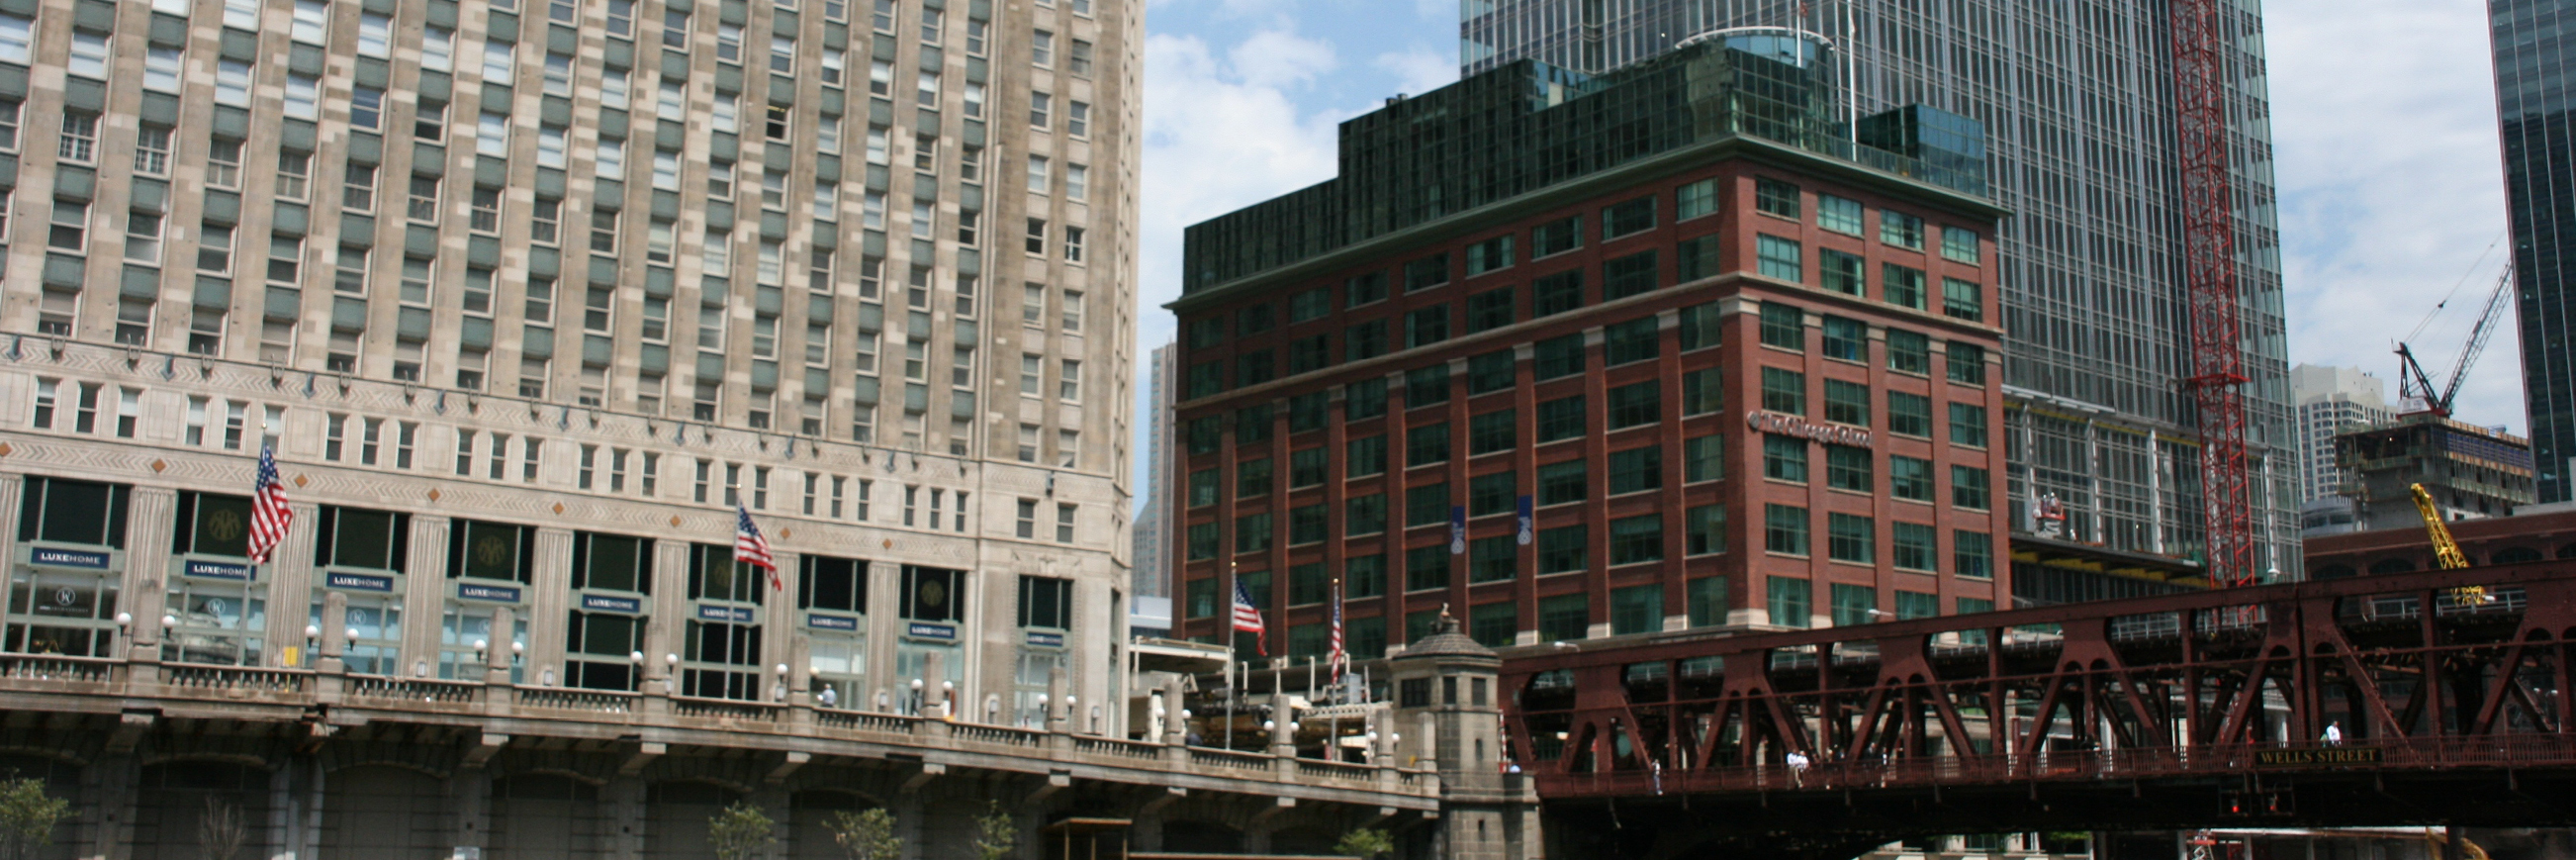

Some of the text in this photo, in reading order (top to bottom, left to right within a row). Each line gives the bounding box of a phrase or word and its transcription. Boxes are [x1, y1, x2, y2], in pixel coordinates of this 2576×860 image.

[41, 552, 101, 565] LUXEHOME
[333, 576, 386, 588] LUXEHOME
[464, 588, 513, 599] LUXEHOME
[703, 609, 747, 620] LUXEHME
[2260, 749, 2377, 764] WELLS STREET
